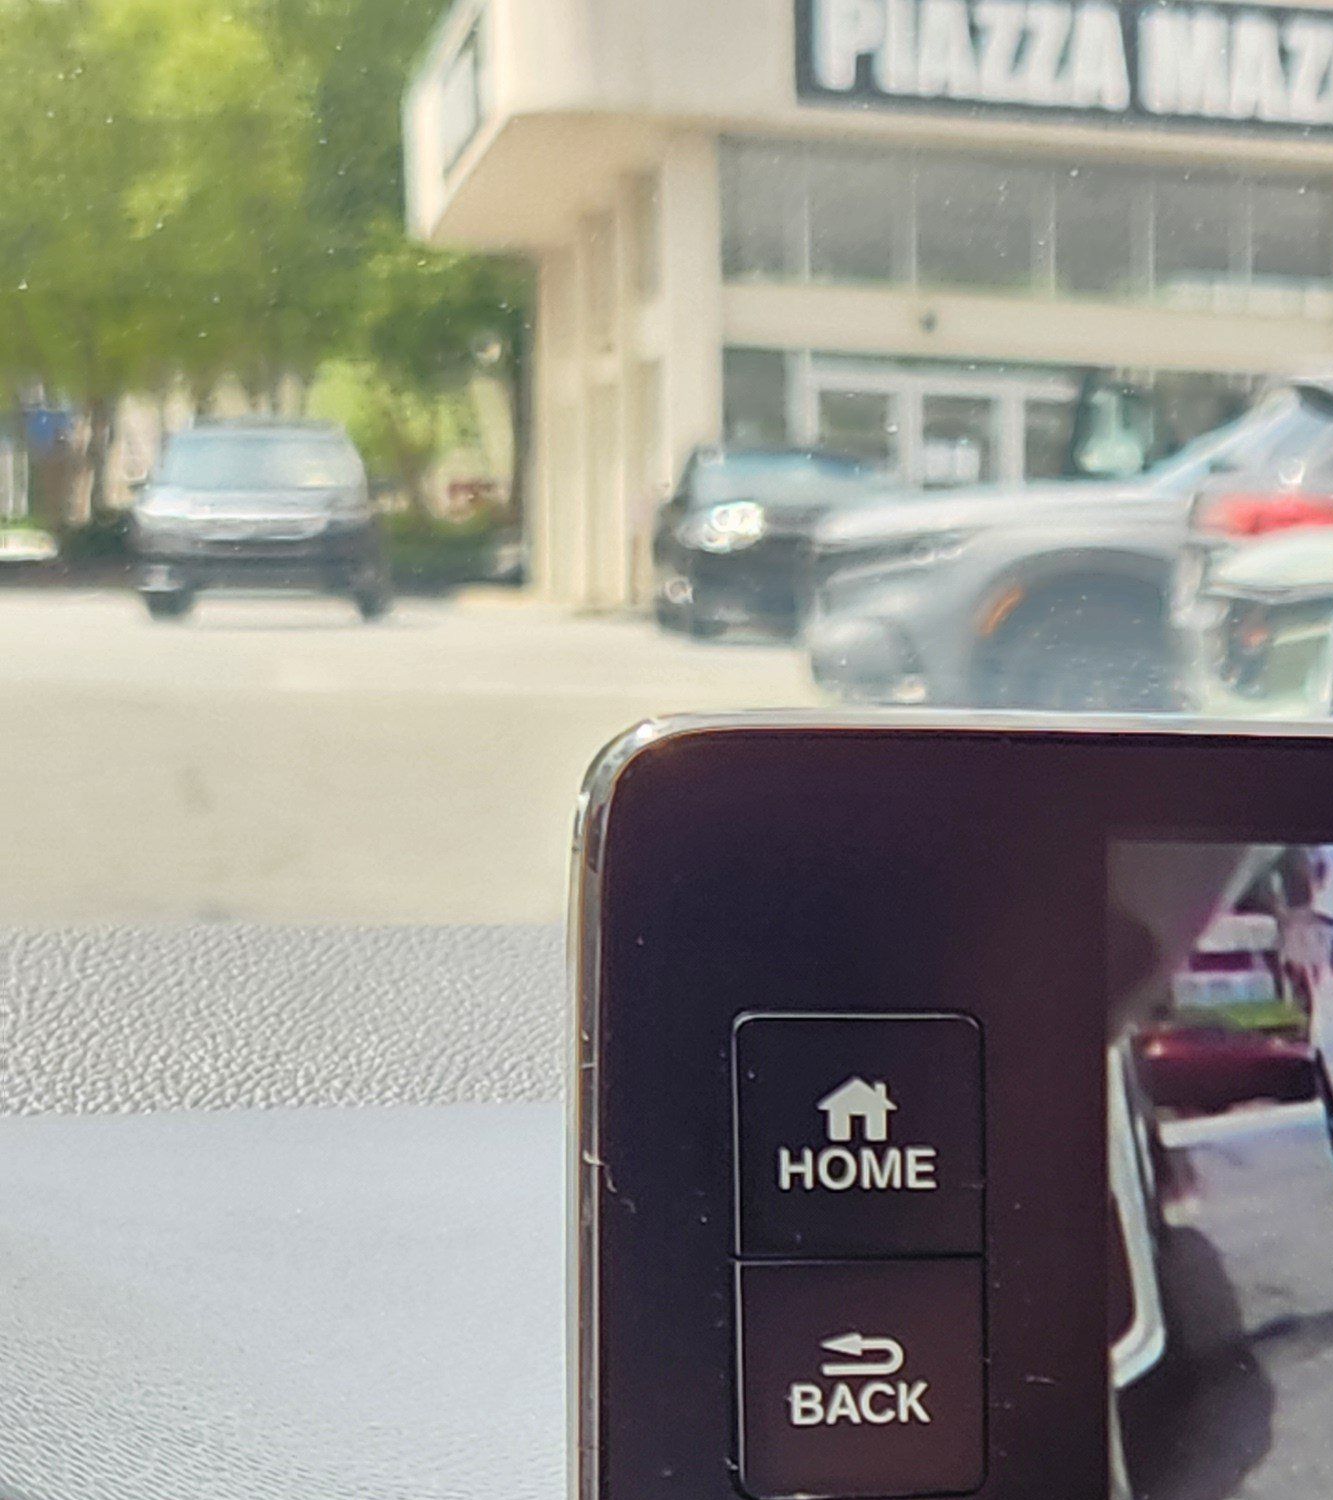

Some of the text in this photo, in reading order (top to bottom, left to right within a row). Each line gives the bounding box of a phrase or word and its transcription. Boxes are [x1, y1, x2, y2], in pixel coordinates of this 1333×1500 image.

[813, 0, 1131, 111] PIAZZA
[779, 1146, 938, 1190] HOME
[789, 1381, 932, 1425] BACK
